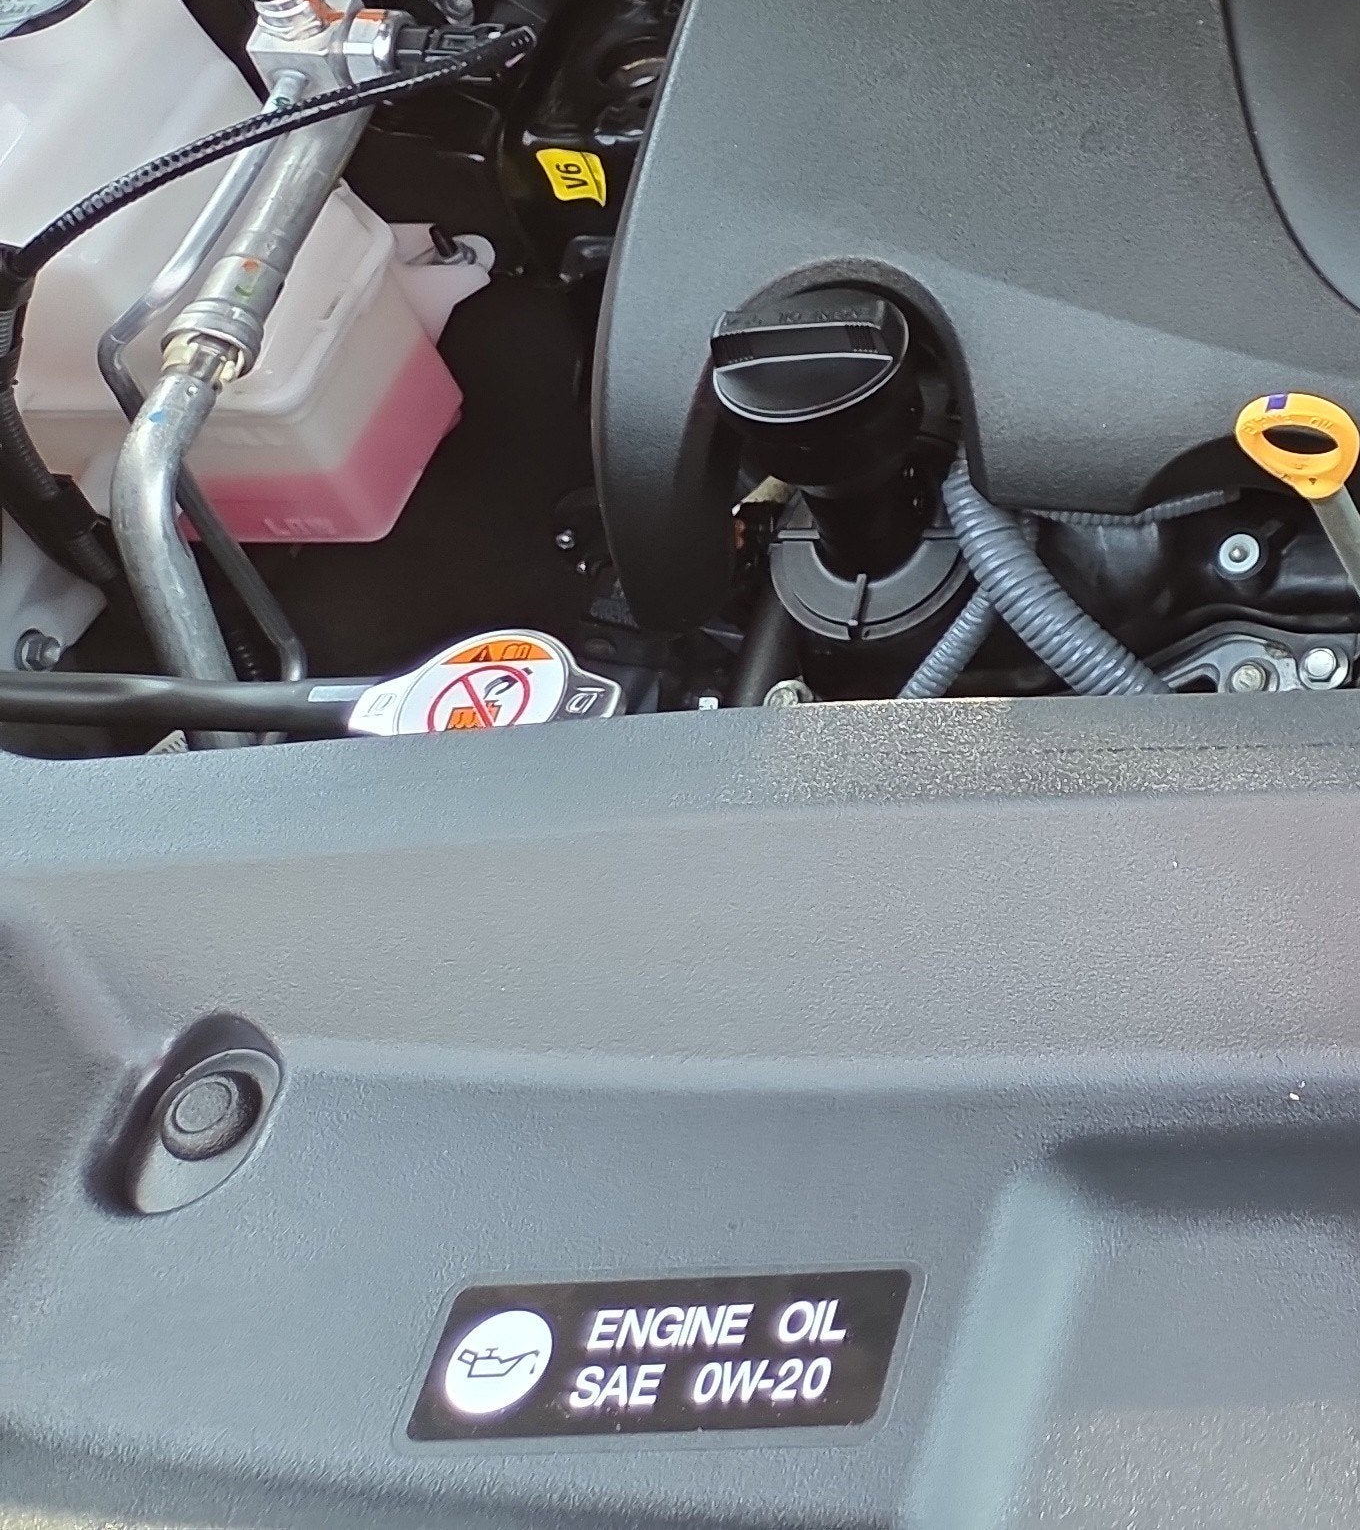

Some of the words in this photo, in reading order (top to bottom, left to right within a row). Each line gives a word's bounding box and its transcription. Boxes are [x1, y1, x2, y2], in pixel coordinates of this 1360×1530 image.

[555, 162, 589, 189] V6
[585, 1302, 755, 1352] ENGINE
[777, 1299, 847, 1343] OIL
[569, 1363, 667, 1409] SAE
[693, 1356, 833, 1404] 0W-20
